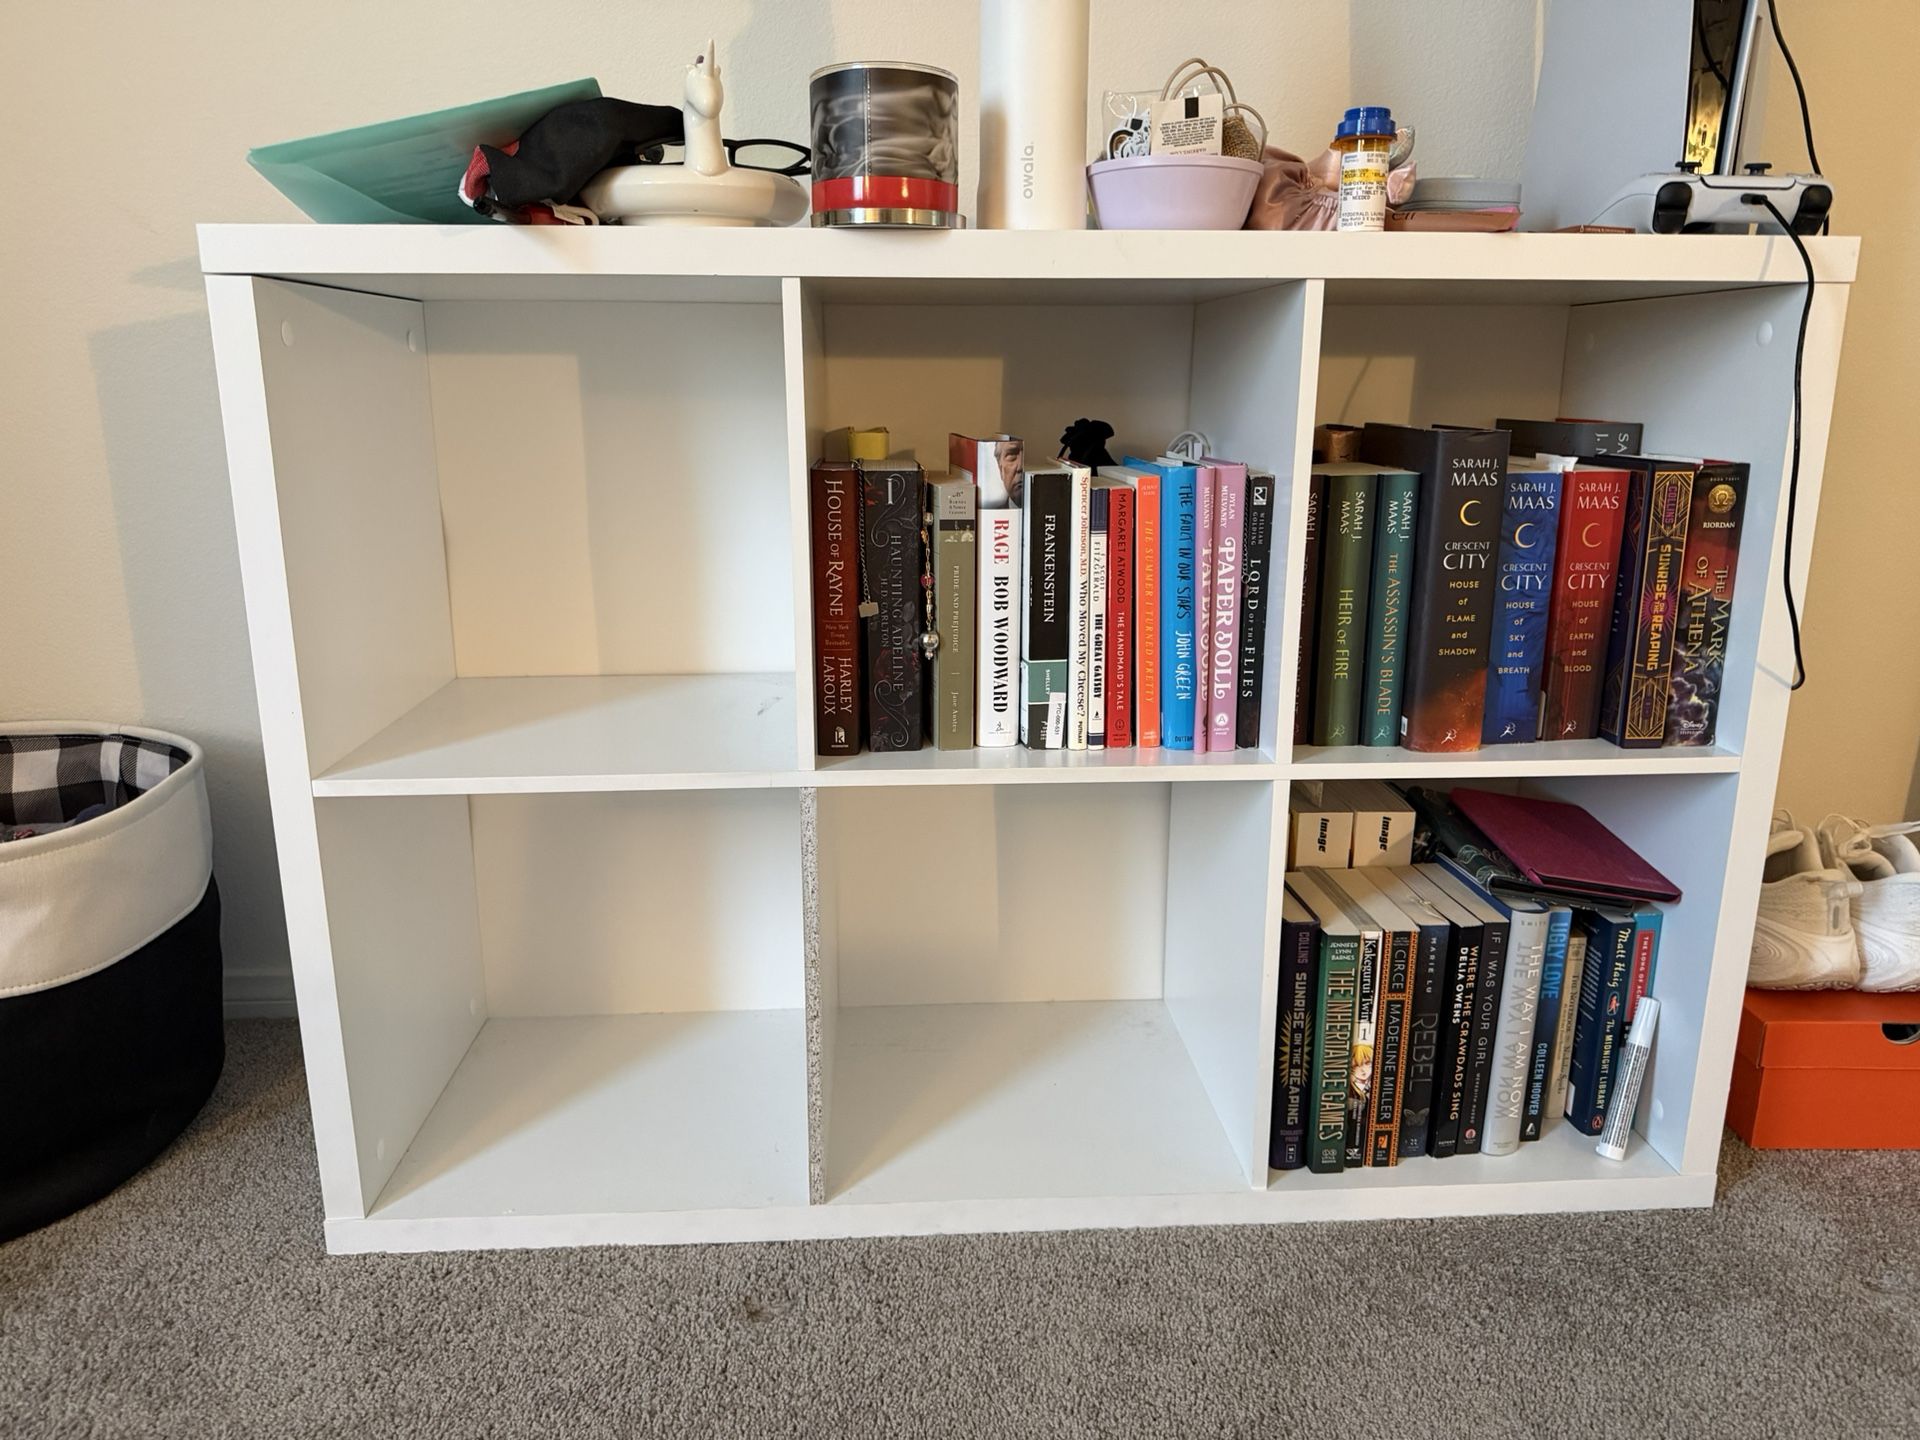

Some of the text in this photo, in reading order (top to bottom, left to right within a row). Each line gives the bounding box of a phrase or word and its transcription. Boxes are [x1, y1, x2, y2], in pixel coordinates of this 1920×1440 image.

[1451, 472, 1498, 487] MAAS
[1452, 458, 1500, 470] SARAH J.
[1078, 476, 1090, 516] Spencer
[1220, 485, 1229, 528] MULVANEY
[1228, 493, 1236, 520] DYLAN
[1508, 496, 1554, 510] MAAS
[1510, 482, 1546, 493] SARAH
[1576, 496, 1620, 510] MAAS
[1578, 482, 1612, 493] SARAH
[1664, 486, 1678, 524] COLLINS
[1251, 511, 1259, 546] GOLDING
[1339, 500, 1351, 535] MAAS
[1355, 491, 1366, 530] SARAH
[1386, 500, 1399, 535] MAAS
[1401, 490, 1413, 531] SARAH
[1703, 521, 1736, 529] RIORDAN
[824, 479, 845, 616] HOUSE OF RAYNE
[993, 519, 1009, 565] RAGE
[1116, 493, 1127, 604] MARGARET ATWOOD
[1176, 483, 1193, 619] THE FAULT IN OUR STARS
[1442, 553, 1490, 571] CITY
[1444, 541, 1491, 551] CRESCENT
[1044, 514, 1056, 624] FRANKENSTEIN
[1092, 541, 1101, 603] FITZGERALD
[1449, 580, 1480, 589] HOUSE
[1501, 574, 1547, 592] CITY
[1503, 563, 1547, 572] CRESCENT
[1567, 573, 1611, 591] CITY
[1569, 562, 1611, 571] CRESCENT
[1654, 543, 1672, 600] SUNRISE
[880, 577, 890, 648] H. D. CARLTON
[889, 534, 904, 693] HAUNTING ADELINE
[993, 576, 1009, 611] BOB
[1144, 519, 1154, 704] THE SUMMER TURNED PRETTY
[1458, 597, 1468, 606] of
[1505, 601, 1536, 609] HOUSE
[1572, 600, 1599, 608] HOUSE
[951, 610, 960, 654] PREJUDICE
[1213, 536, 1236, 699] PAPER DOLL
[1241, 559, 1262, 697] LORD FLIES
[1334, 589, 1354, 680] HEIR OF FIRE
[1446, 613, 1476, 622] FLAME
[1514, 617, 1524, 626] of
[1683, 555, 1713, 674] OF ATHENA
[1709, 566, 1732, 671] THE MARK
[1075, 580, 1089, 717] Who Moved My Cheese?
[1376, 553, 1400, 717] THE ASSASSIN'S BLADE
[1438, 647, 1477, 656] SHADOW
[1451, 631, 1467, 639] and
[1507, 650, 1524, 658] and
[1508, 634, 1526, 642] SKY
[1568, 632, 1594, 641] EARTH
[1571, 649, 1587, 657] and
[1646, 614, 1664, 671] REAPING
[993, 616, 1009, 713] WOODWARD
[1092, 613, 1103, 699] THE GREAT GATSBY
[1115, 611, 1125, 711] THE HANDMAID'S TALE
[1176, 630, 1192, 700] JOHN GREEN
[1498, 666, 1530, 674] BREATH
[1563, 664, 1592, 673] BLOOD
[823, 655, 836, 715] LAROUX
[838, 657, 853, 714] HARLEY
[1681, 720, 1704, 730] Disney
[1298, 931, 1311, 964] COLLINS
[1361, 939, 1377, 995] Kakegurui
[1425, 937, 1438, 993] MARIE LU
[1541, 922, 1569, 1000] UGLY LOVE
[1607, 928, 1632, 988] Matt Haig
[1638, 936, 1649, 971] THE SONG
[1327, 967, 1355, 996] THE
[1391, 949, 1407, 990] CIRCE
[1451, 947, 1469, 1024] DELIA OWENS
[1291, 971, 1307, 1029] SUNRISE
[1475, 960, 1498, 1068] WAS YOUR GIRL
[1449, 945, 1479, 1121] WHERE THE CRAWDADS SING
[1508, 943, 1544, 1119] THE WAY AM NOW
[1291, 1045, 1302, 1064] THE
[1379, 1003, 1401, 1121] MADELINE MILLER
[1409, 1012, 1439, 1092] REBEL
[1533, 1042, 1548, 1080] COLLEEN
[1595, 1034, 1613, 1110] MIDNIGHT LIBRARY
[1286, 1066, 1302, 1126] REAPING
[1318, 1091, 1347, 1140] GAMES
[1528, 1082, 1544, 1116] HOOVER
